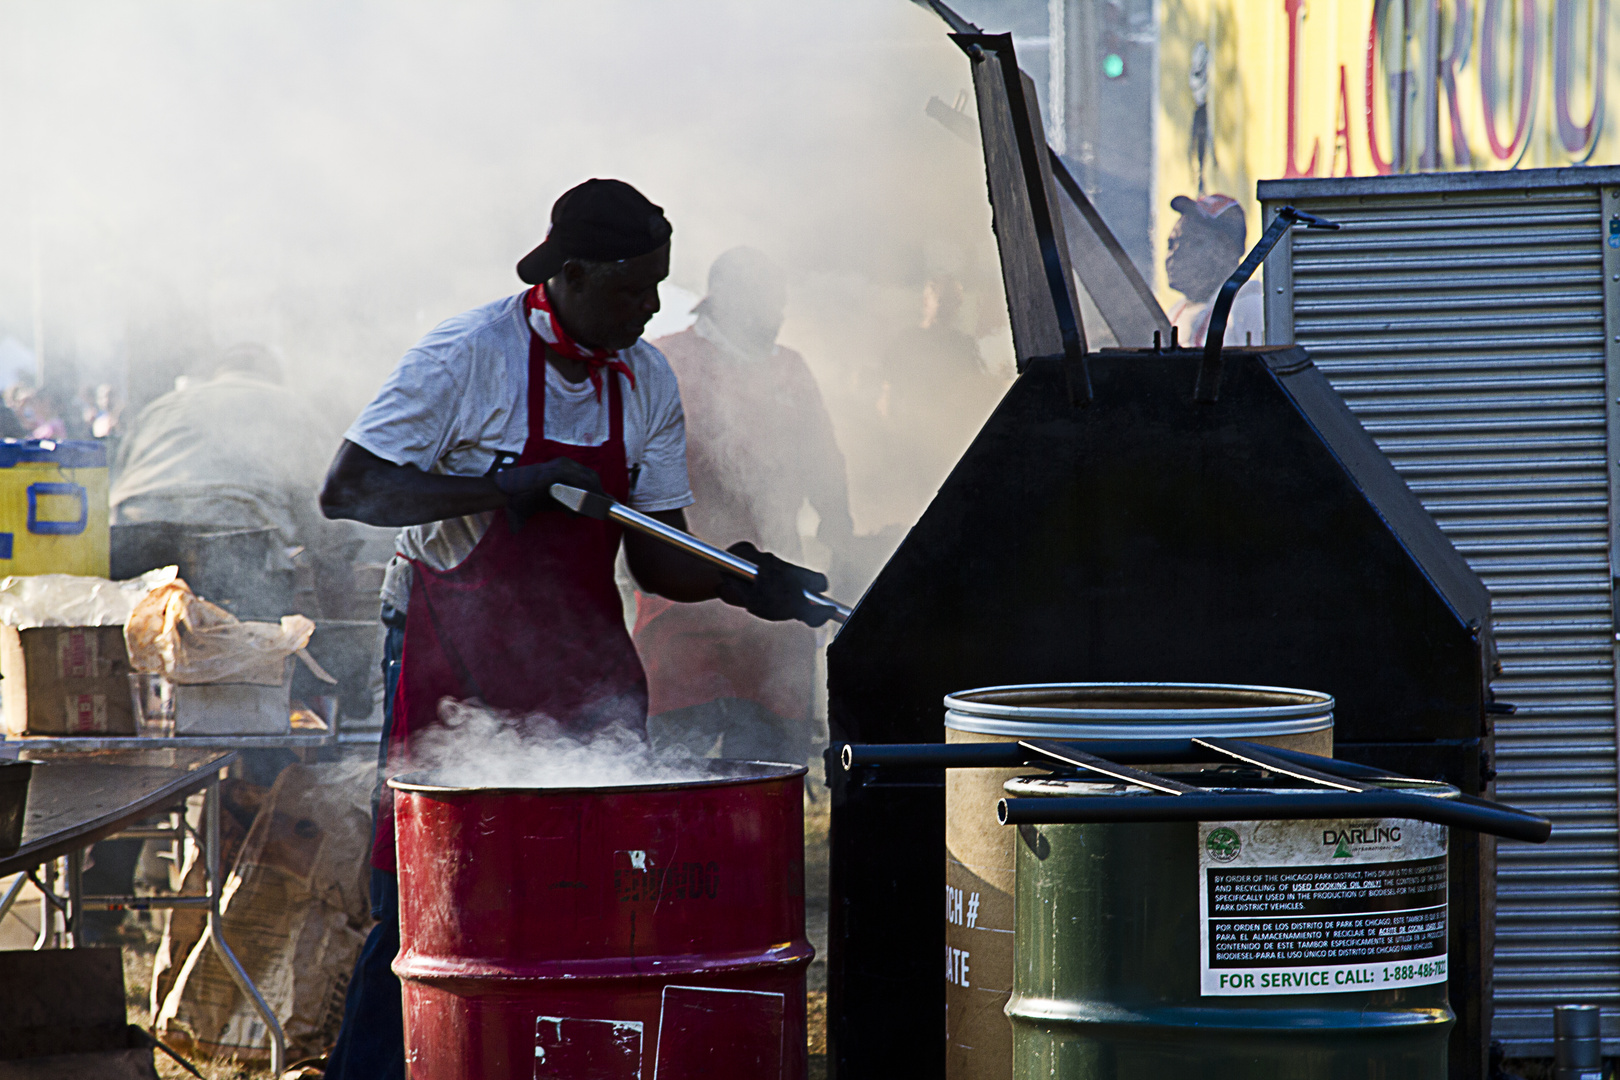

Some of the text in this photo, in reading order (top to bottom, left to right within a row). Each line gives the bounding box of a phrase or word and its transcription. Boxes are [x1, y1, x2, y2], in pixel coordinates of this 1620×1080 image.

[1323, 827, 1401, 845] DARLING
[1215, 875, 1224, 883] BY
[1225, 875, 1251, 883] ORDER
[1265, 874, 1279, 882] THE
[1280, 874, 1313, 882] CHICAGO
[1235, 884, 1275, 892] RECYCLING
[1292, 883, 1312, 892] USED
[1315, 882, 1347, 891] COOKING
[1350, 881, 1360, 889] OIL
[1215, 894, 1263, 902] SPECIFICALLY
[1313, 891, 1357, 900] PRODUCTION
[966, 892, 979, 928] #
[1236, 903, 1268, 911] DISTRICT
[1216, 924, 1231, 932] POR
[1263, 923, 1272, 931] DE
[1291, 922, 1323, 930] DISTRITO
[1325, 921, 1334, 929] DE
[1336, 920, 1353, 928] PARK
[1252, 931, 1322, 940] ALMACENAMIENTO
[1333, 929, 1365, 938] RECICLAJE
[1216, 943, 1260, 951] CONTENIDO
[1264, 942, 1274, 950] DE
[1298, 941, 1328, 949] TAMBOR
[1277, 951, 1285, 959] EL
[1287, 951, 1302, 959] USO
[1304, 949, 1326, 958] ÚNICO
[1328, 949, 1337, 957] DE
[1338, 948, 1366, 957] DISTRITO
[1367, 947, 1375, 955] DE
[1376, 945, 1400, 954] CHICAGO
[1220, 973, 1255, 989] FOR
[1261, 971, 1329, 988] SERVICE
[1334, 969, 1375, 985] CALL:
